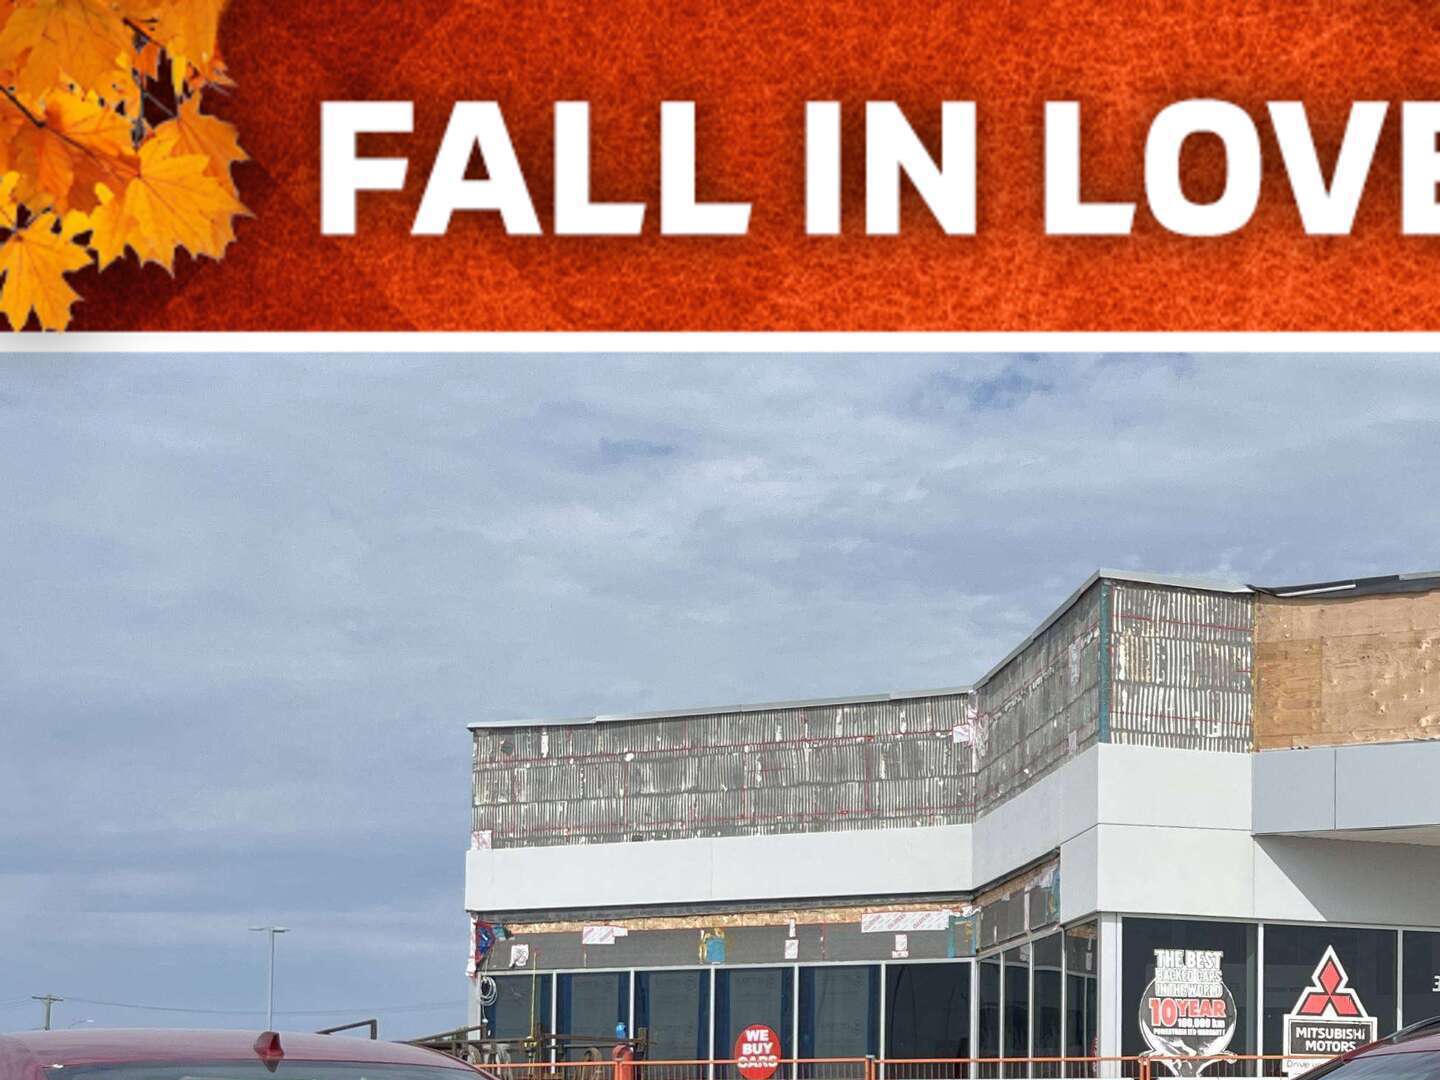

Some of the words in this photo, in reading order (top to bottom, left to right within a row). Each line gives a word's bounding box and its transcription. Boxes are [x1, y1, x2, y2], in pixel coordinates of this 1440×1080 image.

[1154, 949, 1184, 968] THE
[1185, 950, 1223, 969] BEST
[1149, 998, 1177, 1027] 10
[1176, 999, 1226, 1018] YEAR
[745, 1029, 769, 1042] WE
[1296, 1027, 1366, 1040] MITSUBISHI
[742, 1042, 773, 1055] BUY
[1305, 1040, 1356, 1052] MOTORS
[737, 1055, 777, 1069] CARS
